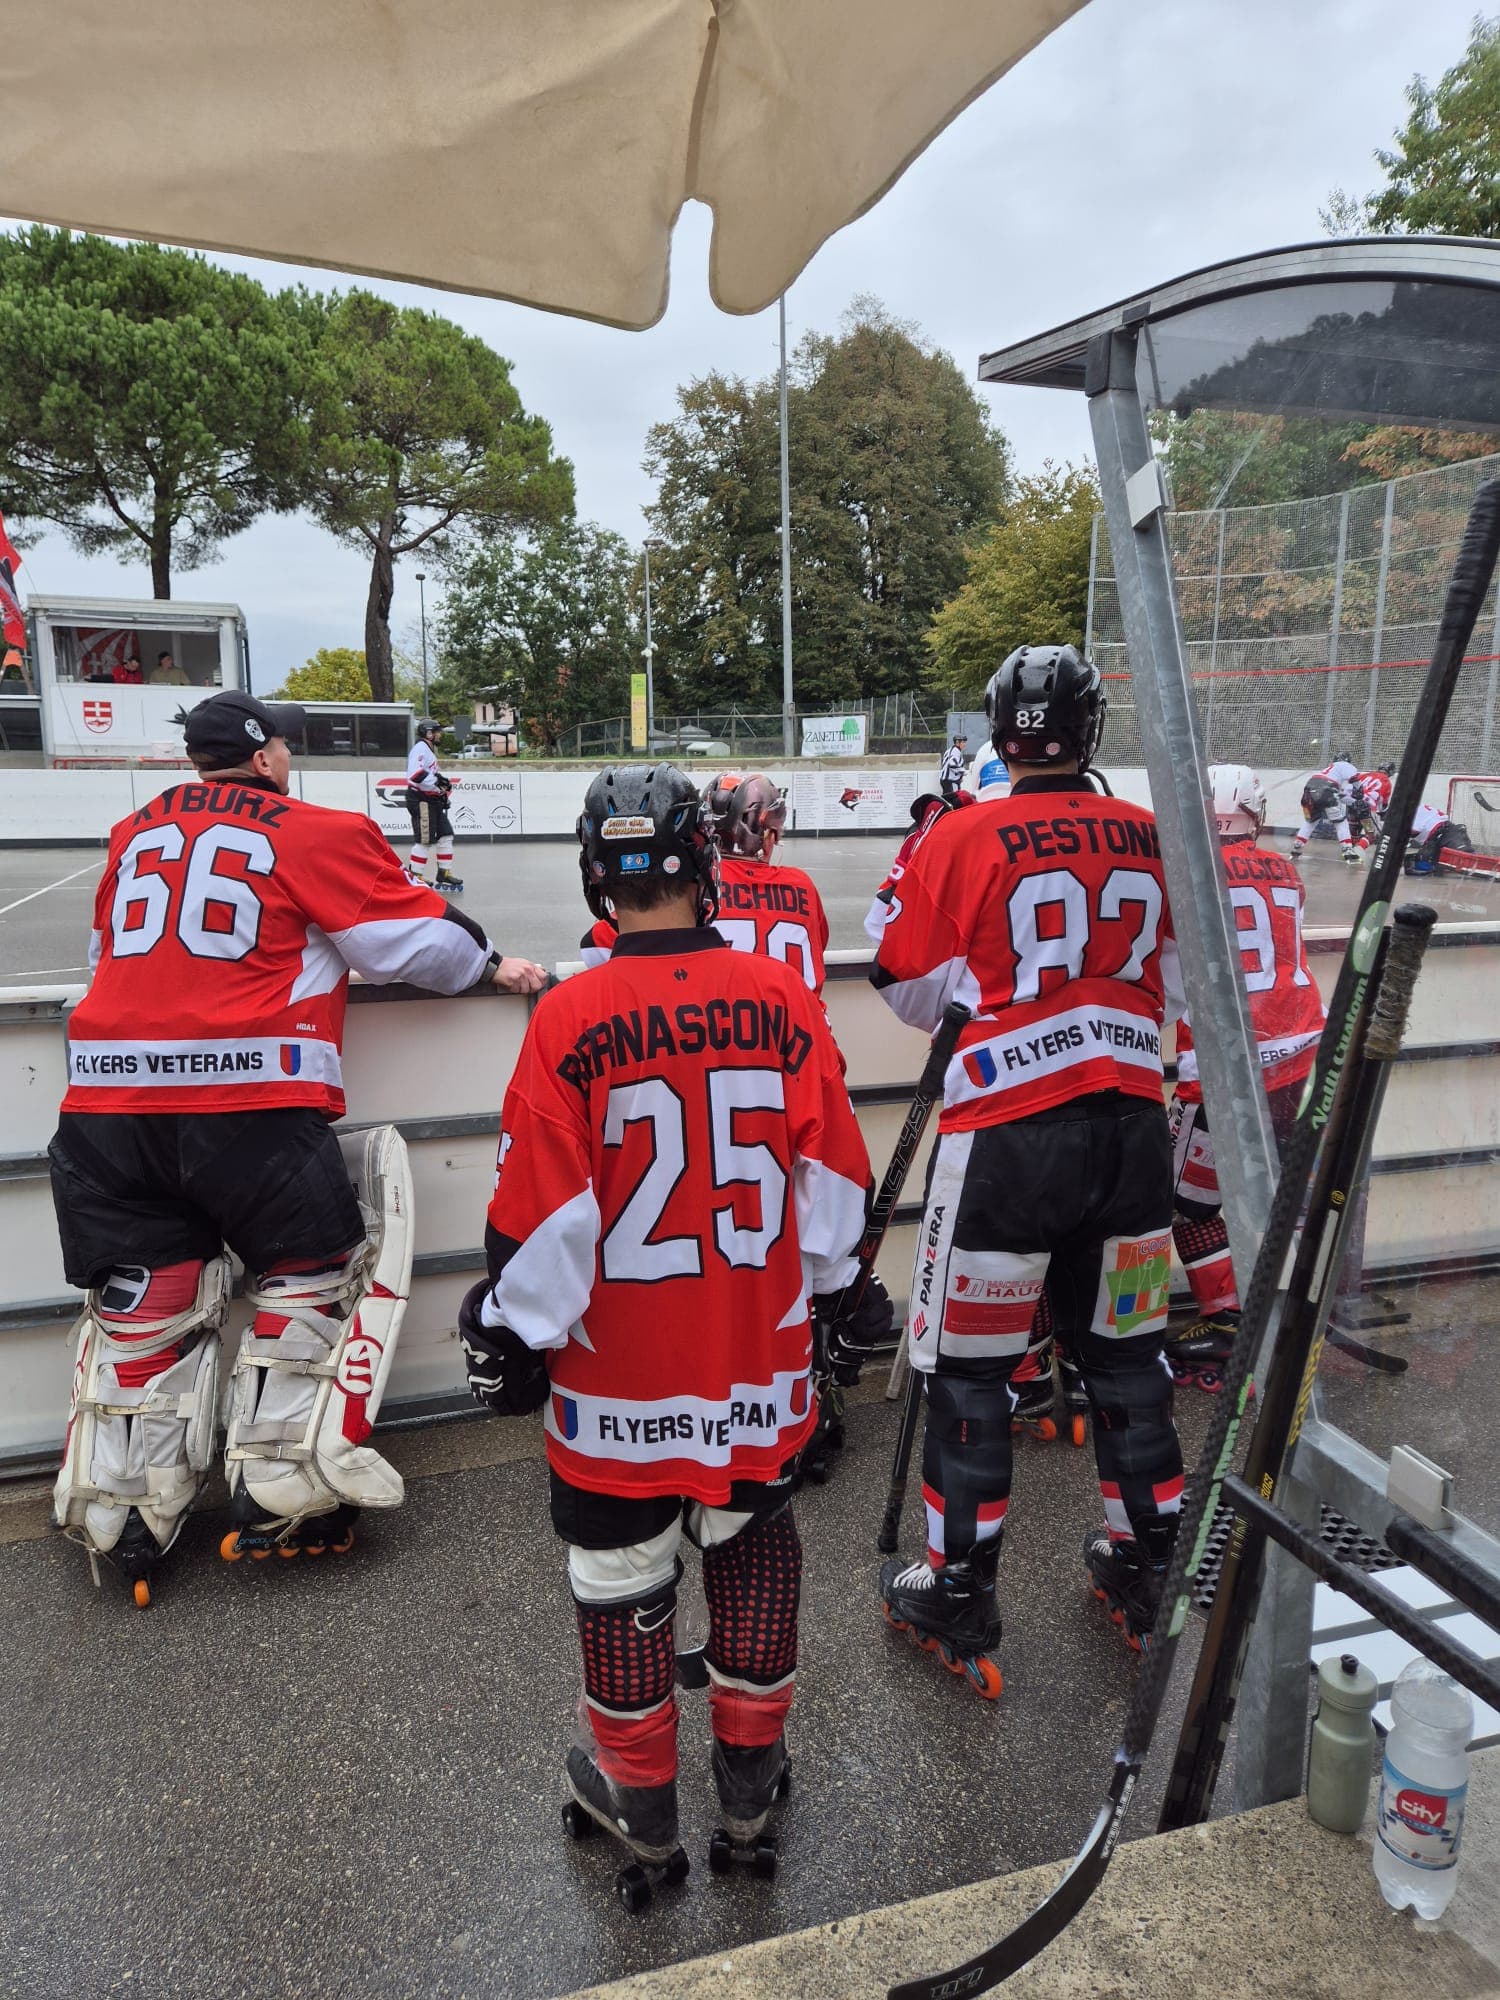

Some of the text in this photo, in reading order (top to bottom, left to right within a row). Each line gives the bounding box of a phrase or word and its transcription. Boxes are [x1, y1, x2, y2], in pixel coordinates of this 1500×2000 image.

[805, 730, 845, 743] ZANETTI
[1015, 710, 1046, 729] 82
[451, 783, 515, 791] RAGEVALLONE
[110, 822, 277, 962] 66
[720, 881, 810, 917] RCHIDE
[76, 1051, 264, 1074] FLYERS VETERANS
[1003, 1018, 1160, 1071] FLYERS VTERANS
[600, 1065, 789, 1285] 25
[920, 1205, 946, 1306] PANZERA
[598, 1400, 777, 1447] FLYERS VERAN
